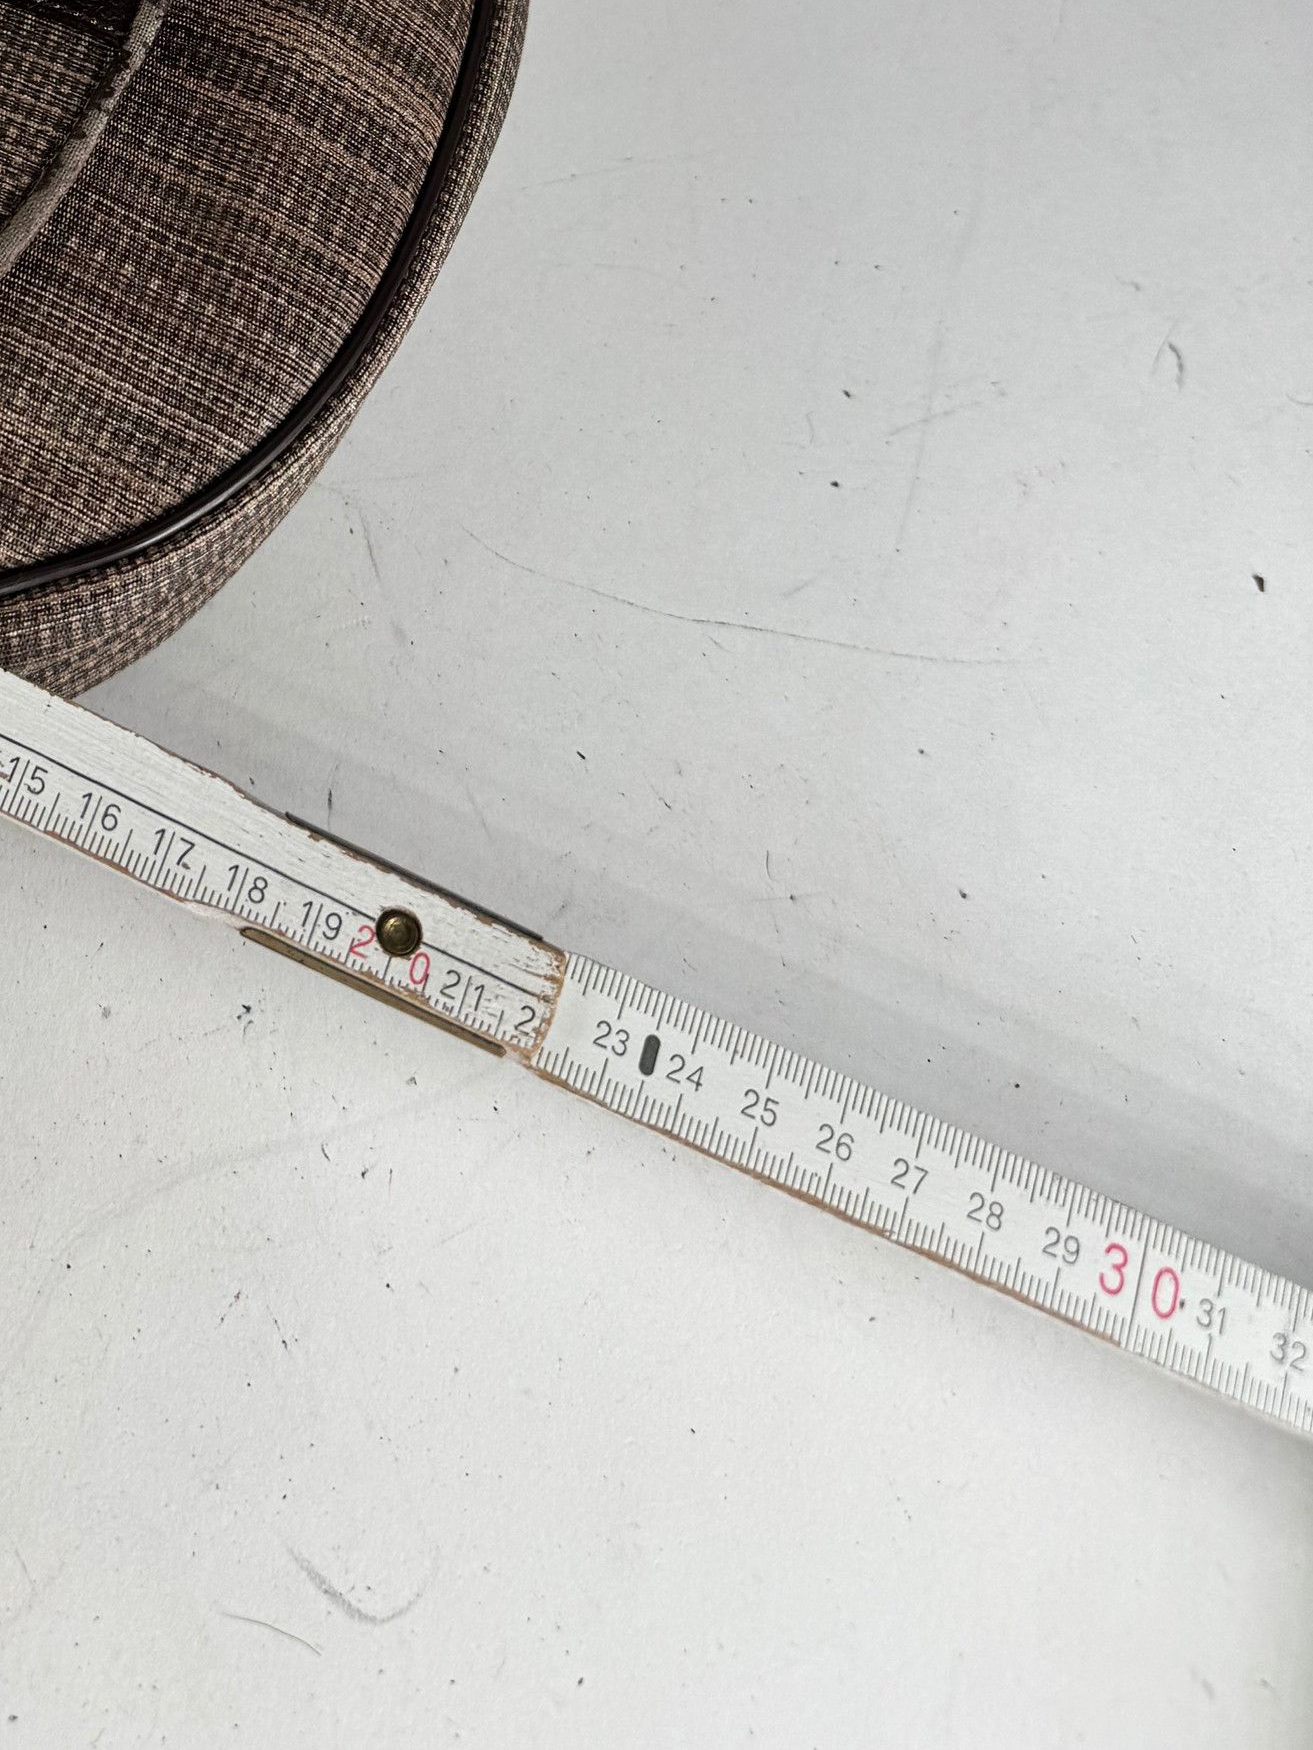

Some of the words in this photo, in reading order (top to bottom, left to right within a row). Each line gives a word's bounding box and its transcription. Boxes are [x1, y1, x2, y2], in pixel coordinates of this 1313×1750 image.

[8, 756, 47, 796] 15
[80, 791, 123, 832] 16
[153, 828, 196, 870] 17
[227, 864, 269, 904] 18
[300, 900, 344, 941] 19
[514, 1004, 537, 1037] 2
[592, 1019, 631, 1057] 23
[665, 1053, 706, 1093] 24
[740, 1088, 780, 1127] 25
[815, 1123, 856, 1162] 26
[890, 1158, 930, 1195] 27
[966, 1192, 1006, 1232] 28
[1042, 1226, 1082, 1265] 29
[1099, 1242, 1181, 1321] 30
[1196, 1297, 1228, 1336] 31
[1270, 1331, 1308, 1372] 32
